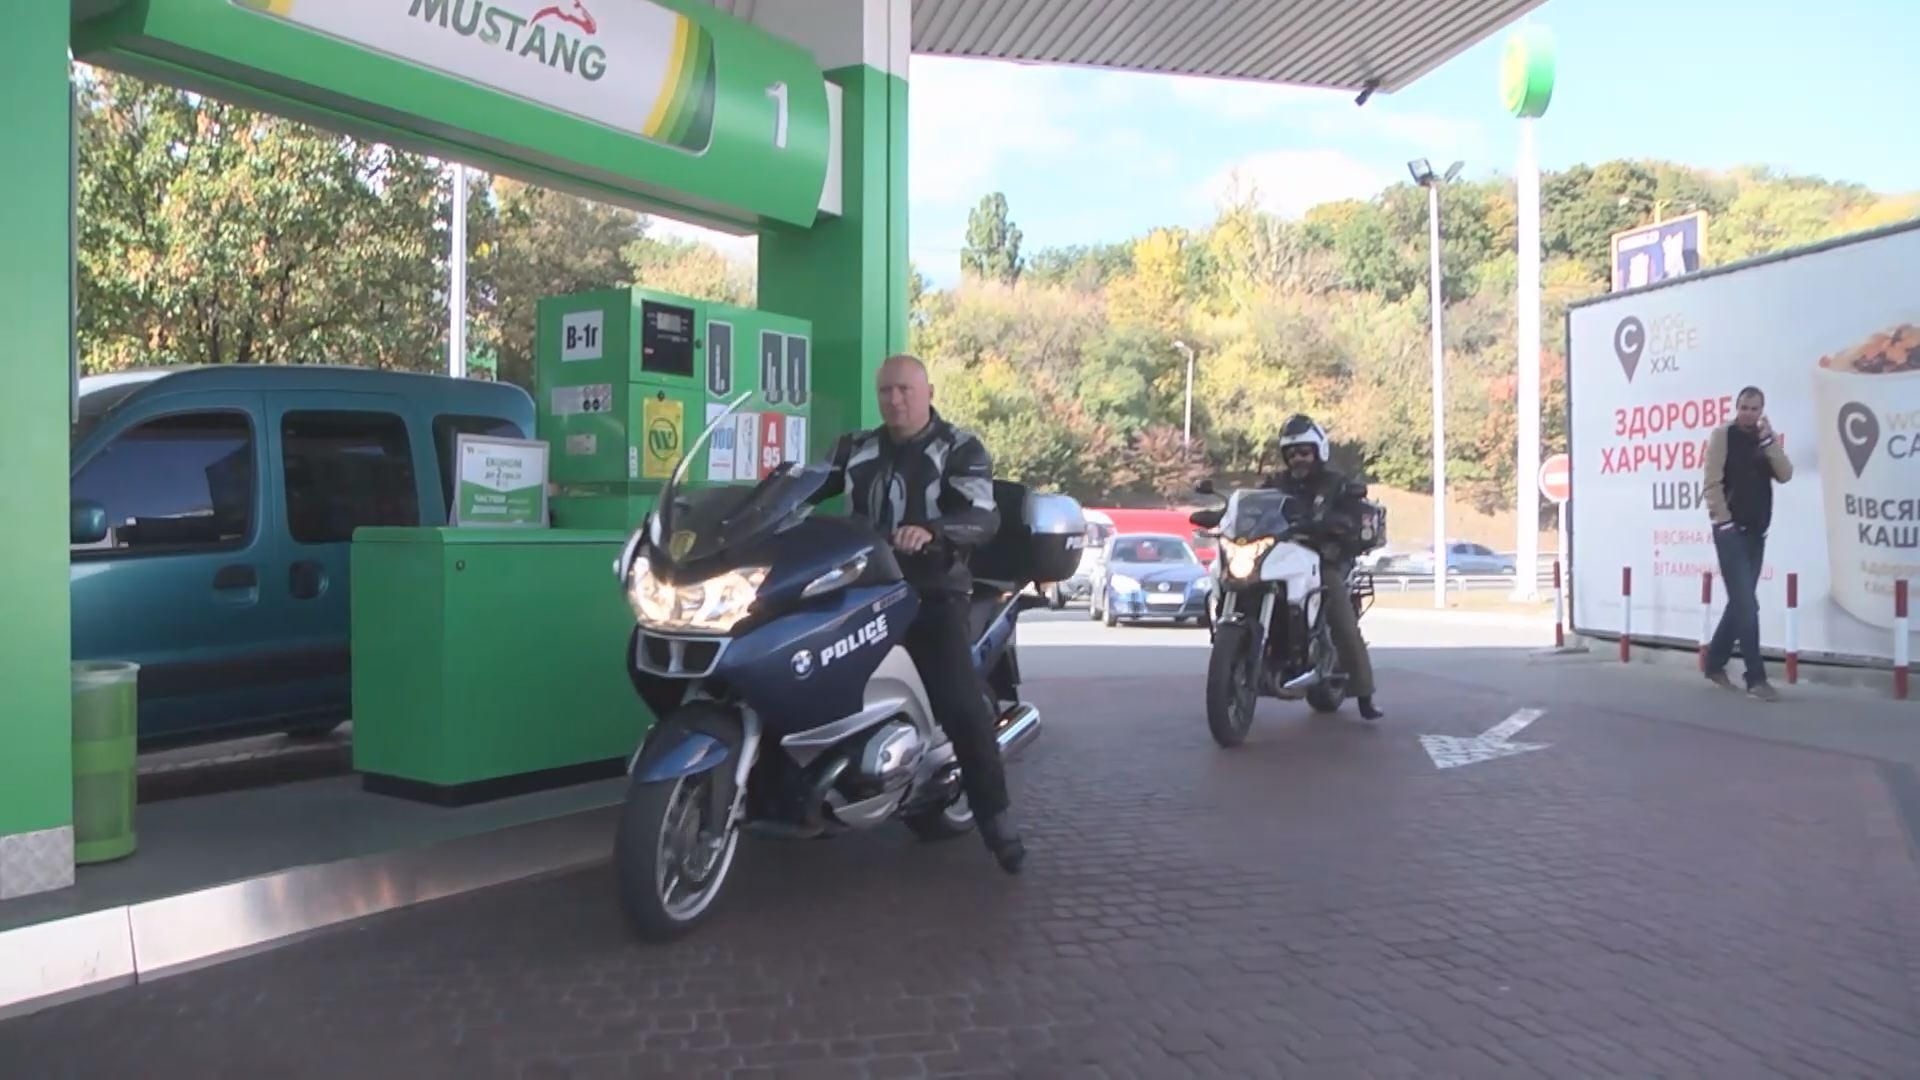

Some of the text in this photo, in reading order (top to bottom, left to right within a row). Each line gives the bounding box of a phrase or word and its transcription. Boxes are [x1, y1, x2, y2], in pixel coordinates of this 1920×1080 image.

[407, 0, 607, 82] MUSTANG
[765, 81, 789, 150] 1
[1650, 355, 1680, 374] XXL
[1615, 396, 1733, 440] ЗДОРОВЕ
[763, 446, 781, 469] 95
[1845, 494, 1920, 522] ВІВСЯ
[820, 613, 888, 667] POLICE
